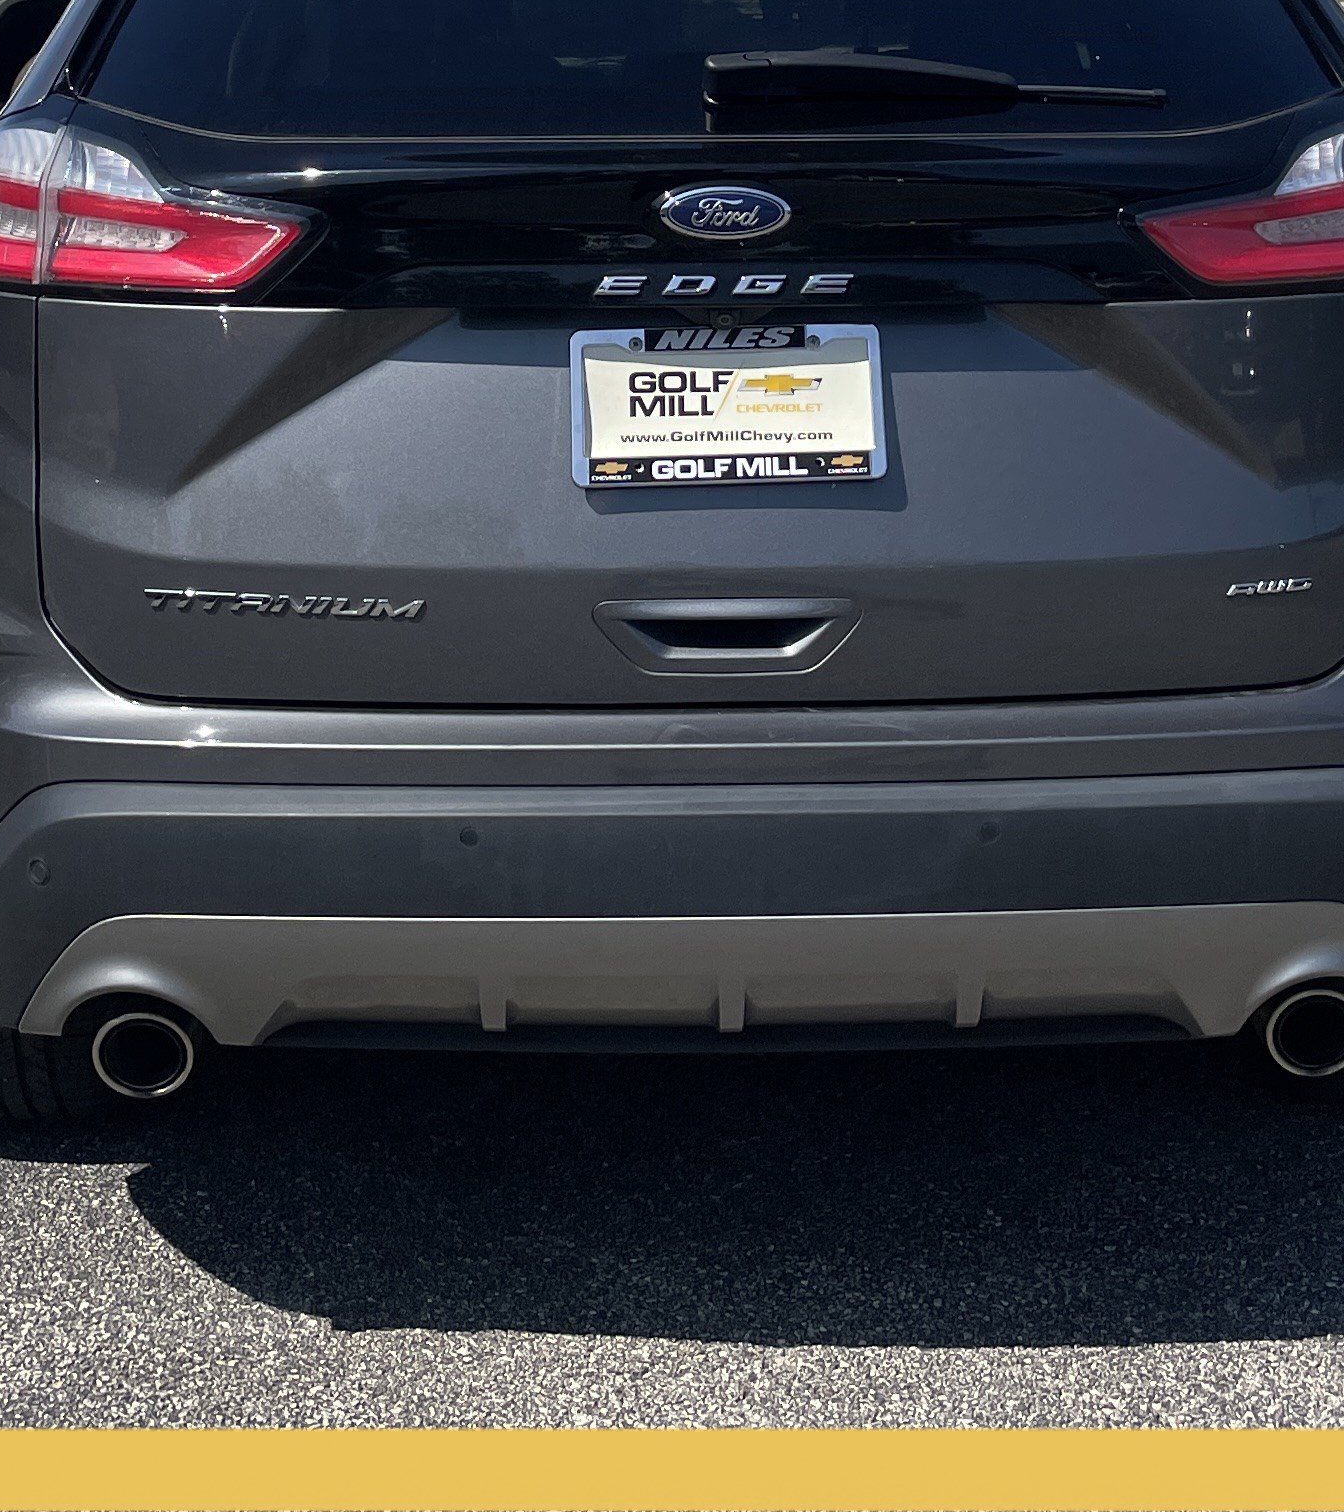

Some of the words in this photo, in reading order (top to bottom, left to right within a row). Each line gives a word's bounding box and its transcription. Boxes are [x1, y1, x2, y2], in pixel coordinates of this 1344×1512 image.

[691, 197, 760, 227] Ford
[593, 273, 855, 297] EDGE
[654, 326, 796, 351] NILES
[628, 370, 736, 394] GOLF
[628, 395, 716, 418] MILL
[736, 403, 824, 414] CHEVROLET
[620, 430, 834, 444] www.GolfMillChevy.com
[651, 458, 733, 480] GOLF
[735, 456, 809, 478] MILL
[143, 587, 427, 619] TITANIUM
